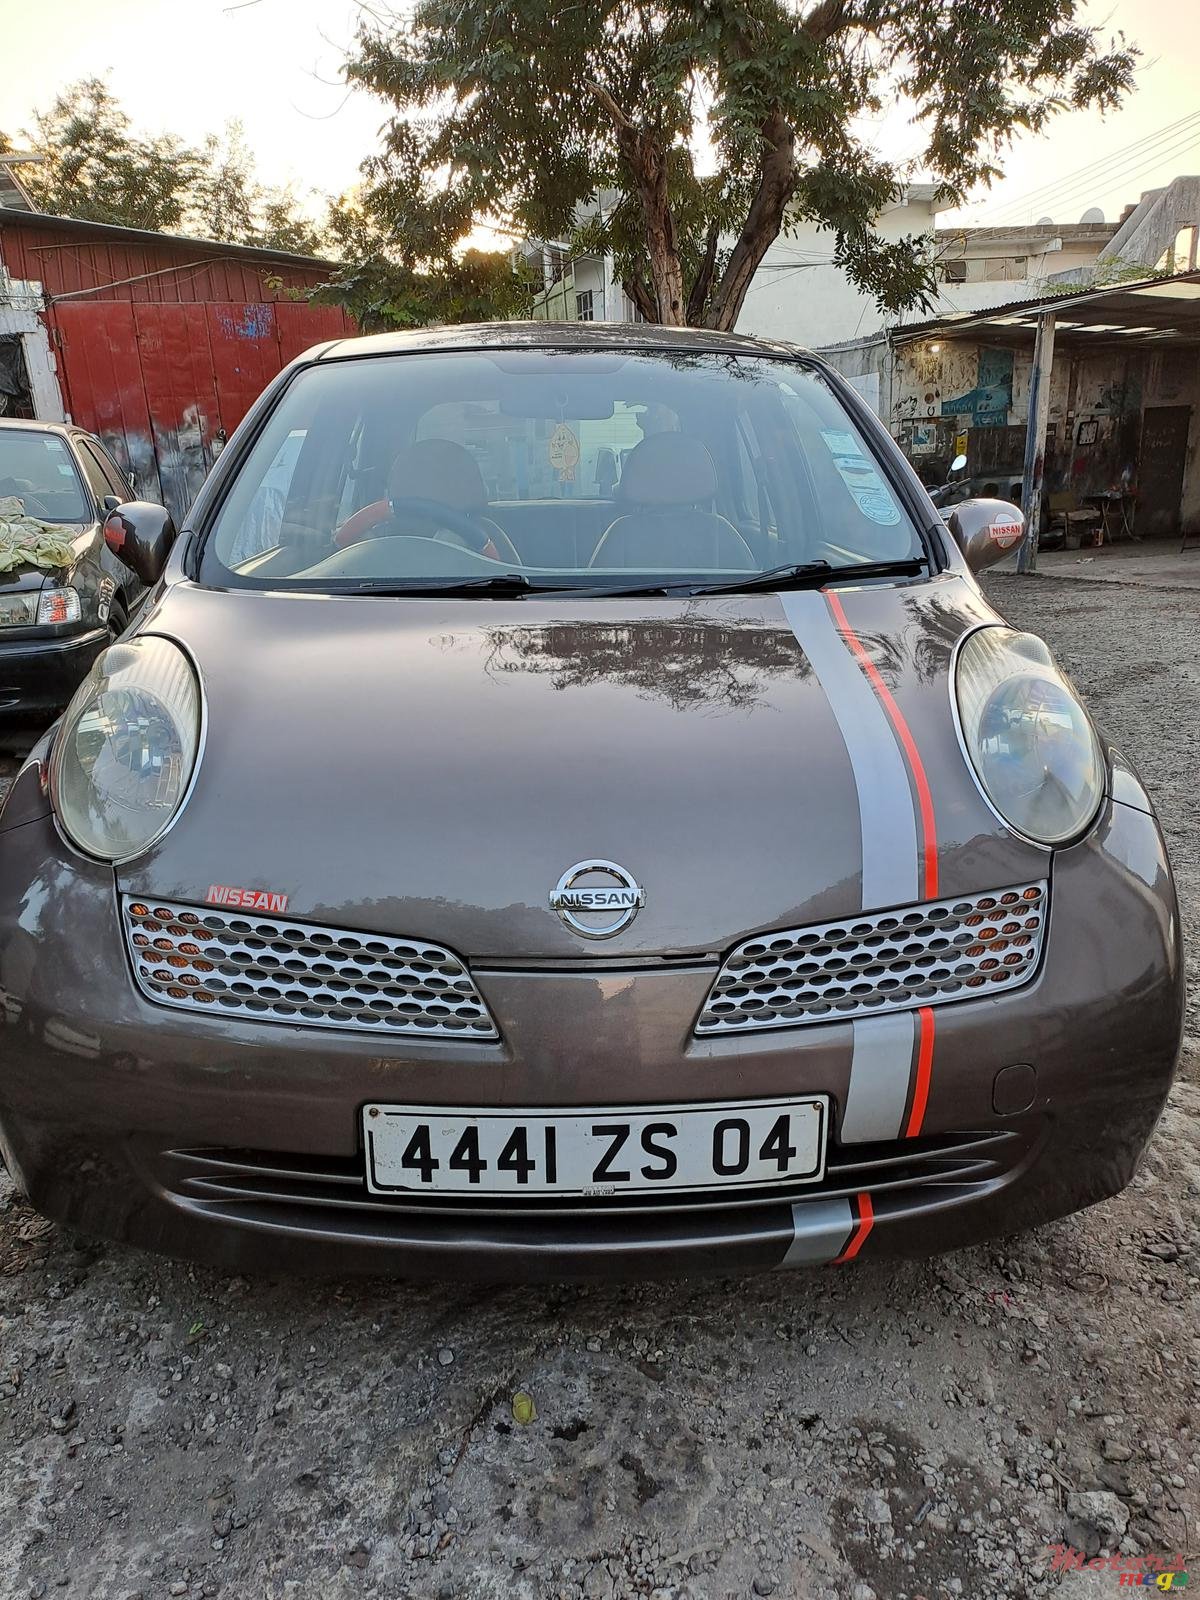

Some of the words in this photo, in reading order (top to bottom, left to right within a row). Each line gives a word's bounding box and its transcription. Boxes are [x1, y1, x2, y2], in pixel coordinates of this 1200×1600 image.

[992, 525, 1021, 536] NISSAN
[205, 885, 289, 912] NISSAN
[559, 892, 635, 906] NISSAN
[401, 1124, 557, 1184] 4441
[591, 1122, 678, 1183] ZS
[712, 1114, 797, 1177] 04
